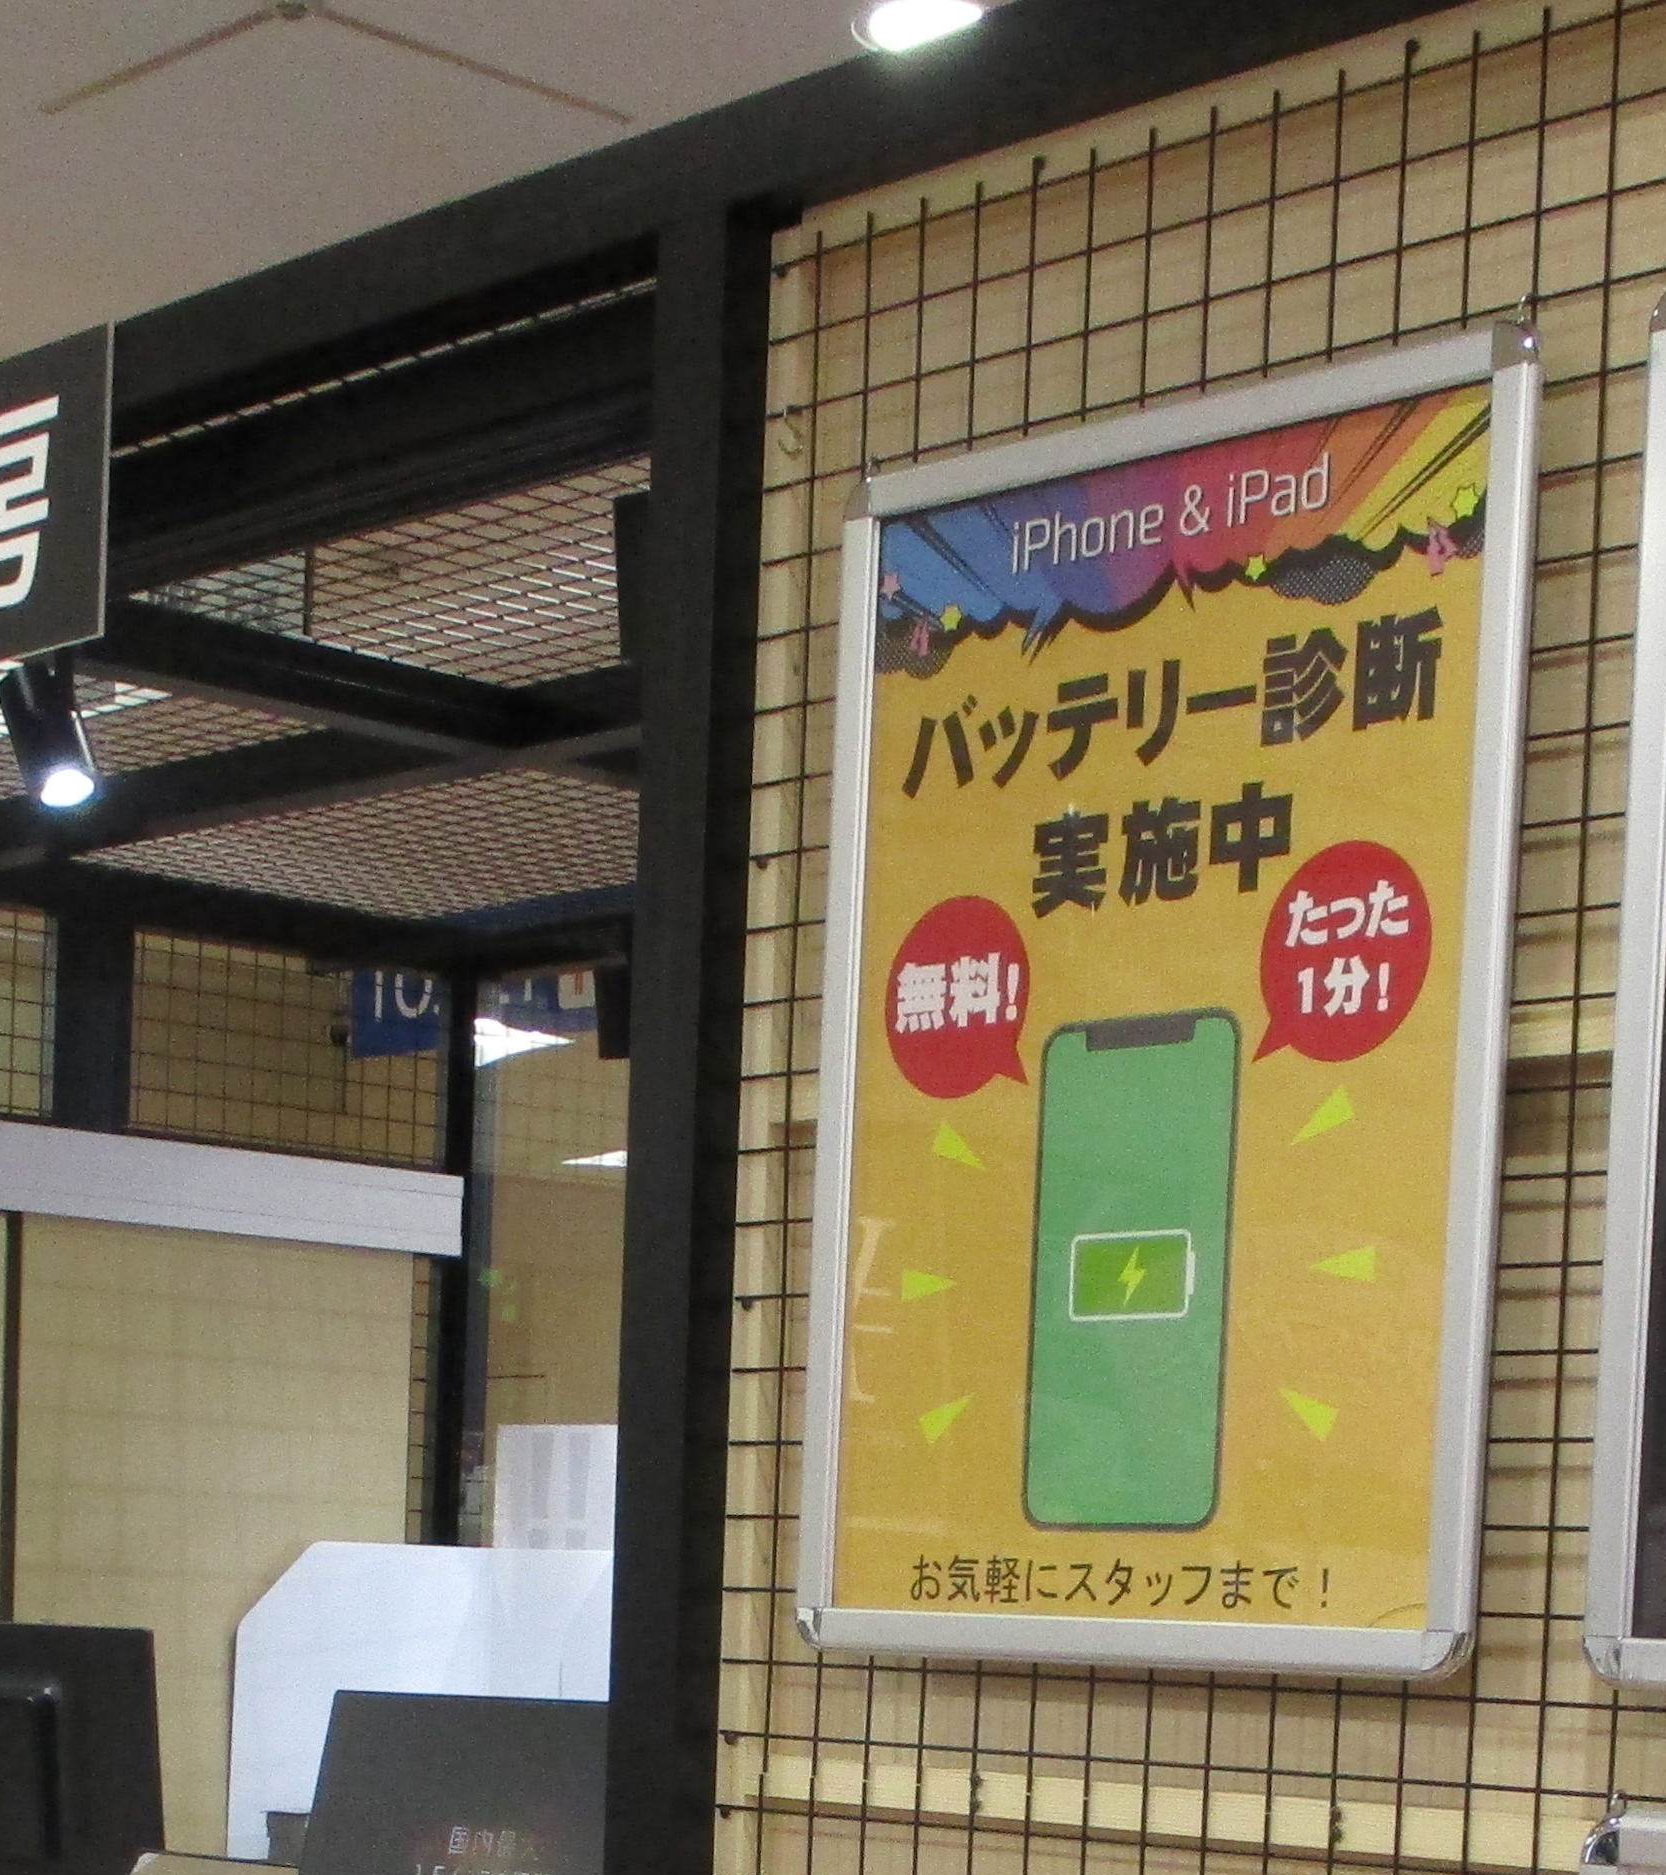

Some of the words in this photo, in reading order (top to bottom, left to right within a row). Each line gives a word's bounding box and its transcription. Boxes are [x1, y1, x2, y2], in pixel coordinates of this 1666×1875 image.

[1010, 517, 1162, 575] iPhone
[1179, 485, 1209, 537] &
[1225, 453, 1331, 527] iPad
[902, 607, 1443, 798] バッテリー診断
[1031, 782, 1293, 919] 実施中
[1285, 880, 1410, 947] たった
[895, 953, 1020, 1033] 無料!
[1297, 957, 1391, 1017] 1分!
